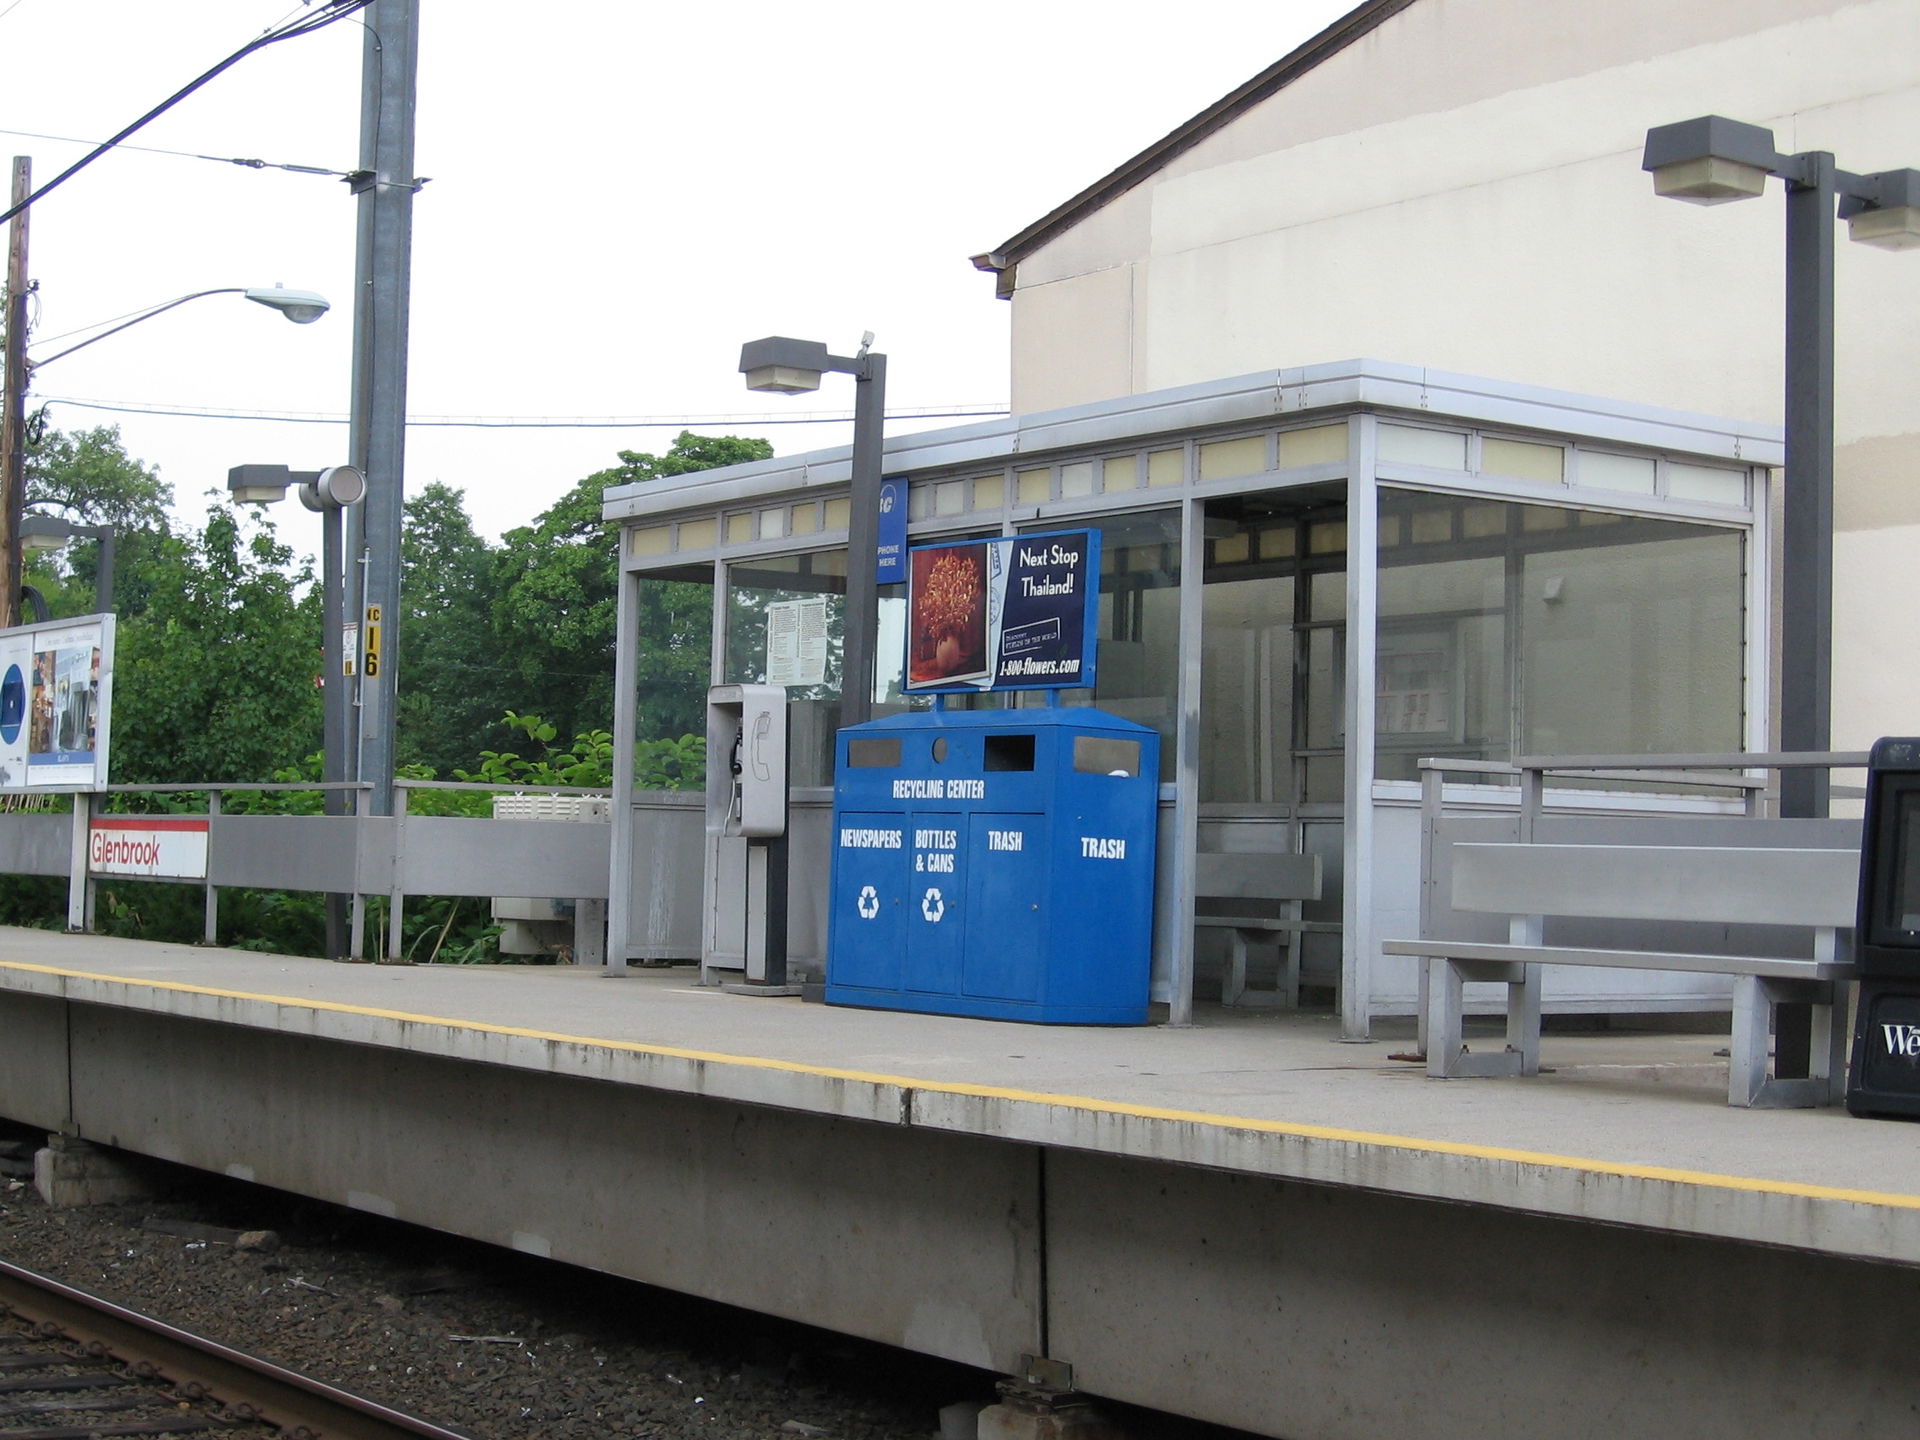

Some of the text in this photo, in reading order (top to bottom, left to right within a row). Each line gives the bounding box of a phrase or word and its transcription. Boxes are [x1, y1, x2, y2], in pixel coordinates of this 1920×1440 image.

[877, 544, 899, 555] PHONE
[1020, 548, 1048, 568] Next
[1051, 544, 1079, 568] Stop
[879, 557, 897, 567] HERE
[1021, 573, 1074, 597] Thailand!
[1000, 656, 1080, 677] 1-800-flowers.com
[892, 779, 985, 799] RECYCLING CENTER
[91, 832, 160, 866] Glenbrook
[840, 828, 902, 849] NEWSPAPERS
[915, 829, 957, 849] BOTTLES
[987, 830, 1023, 852] TRASH
[1080, 836, 1126, 860] TRASH
[915, 852, 955, 873] & CANS
